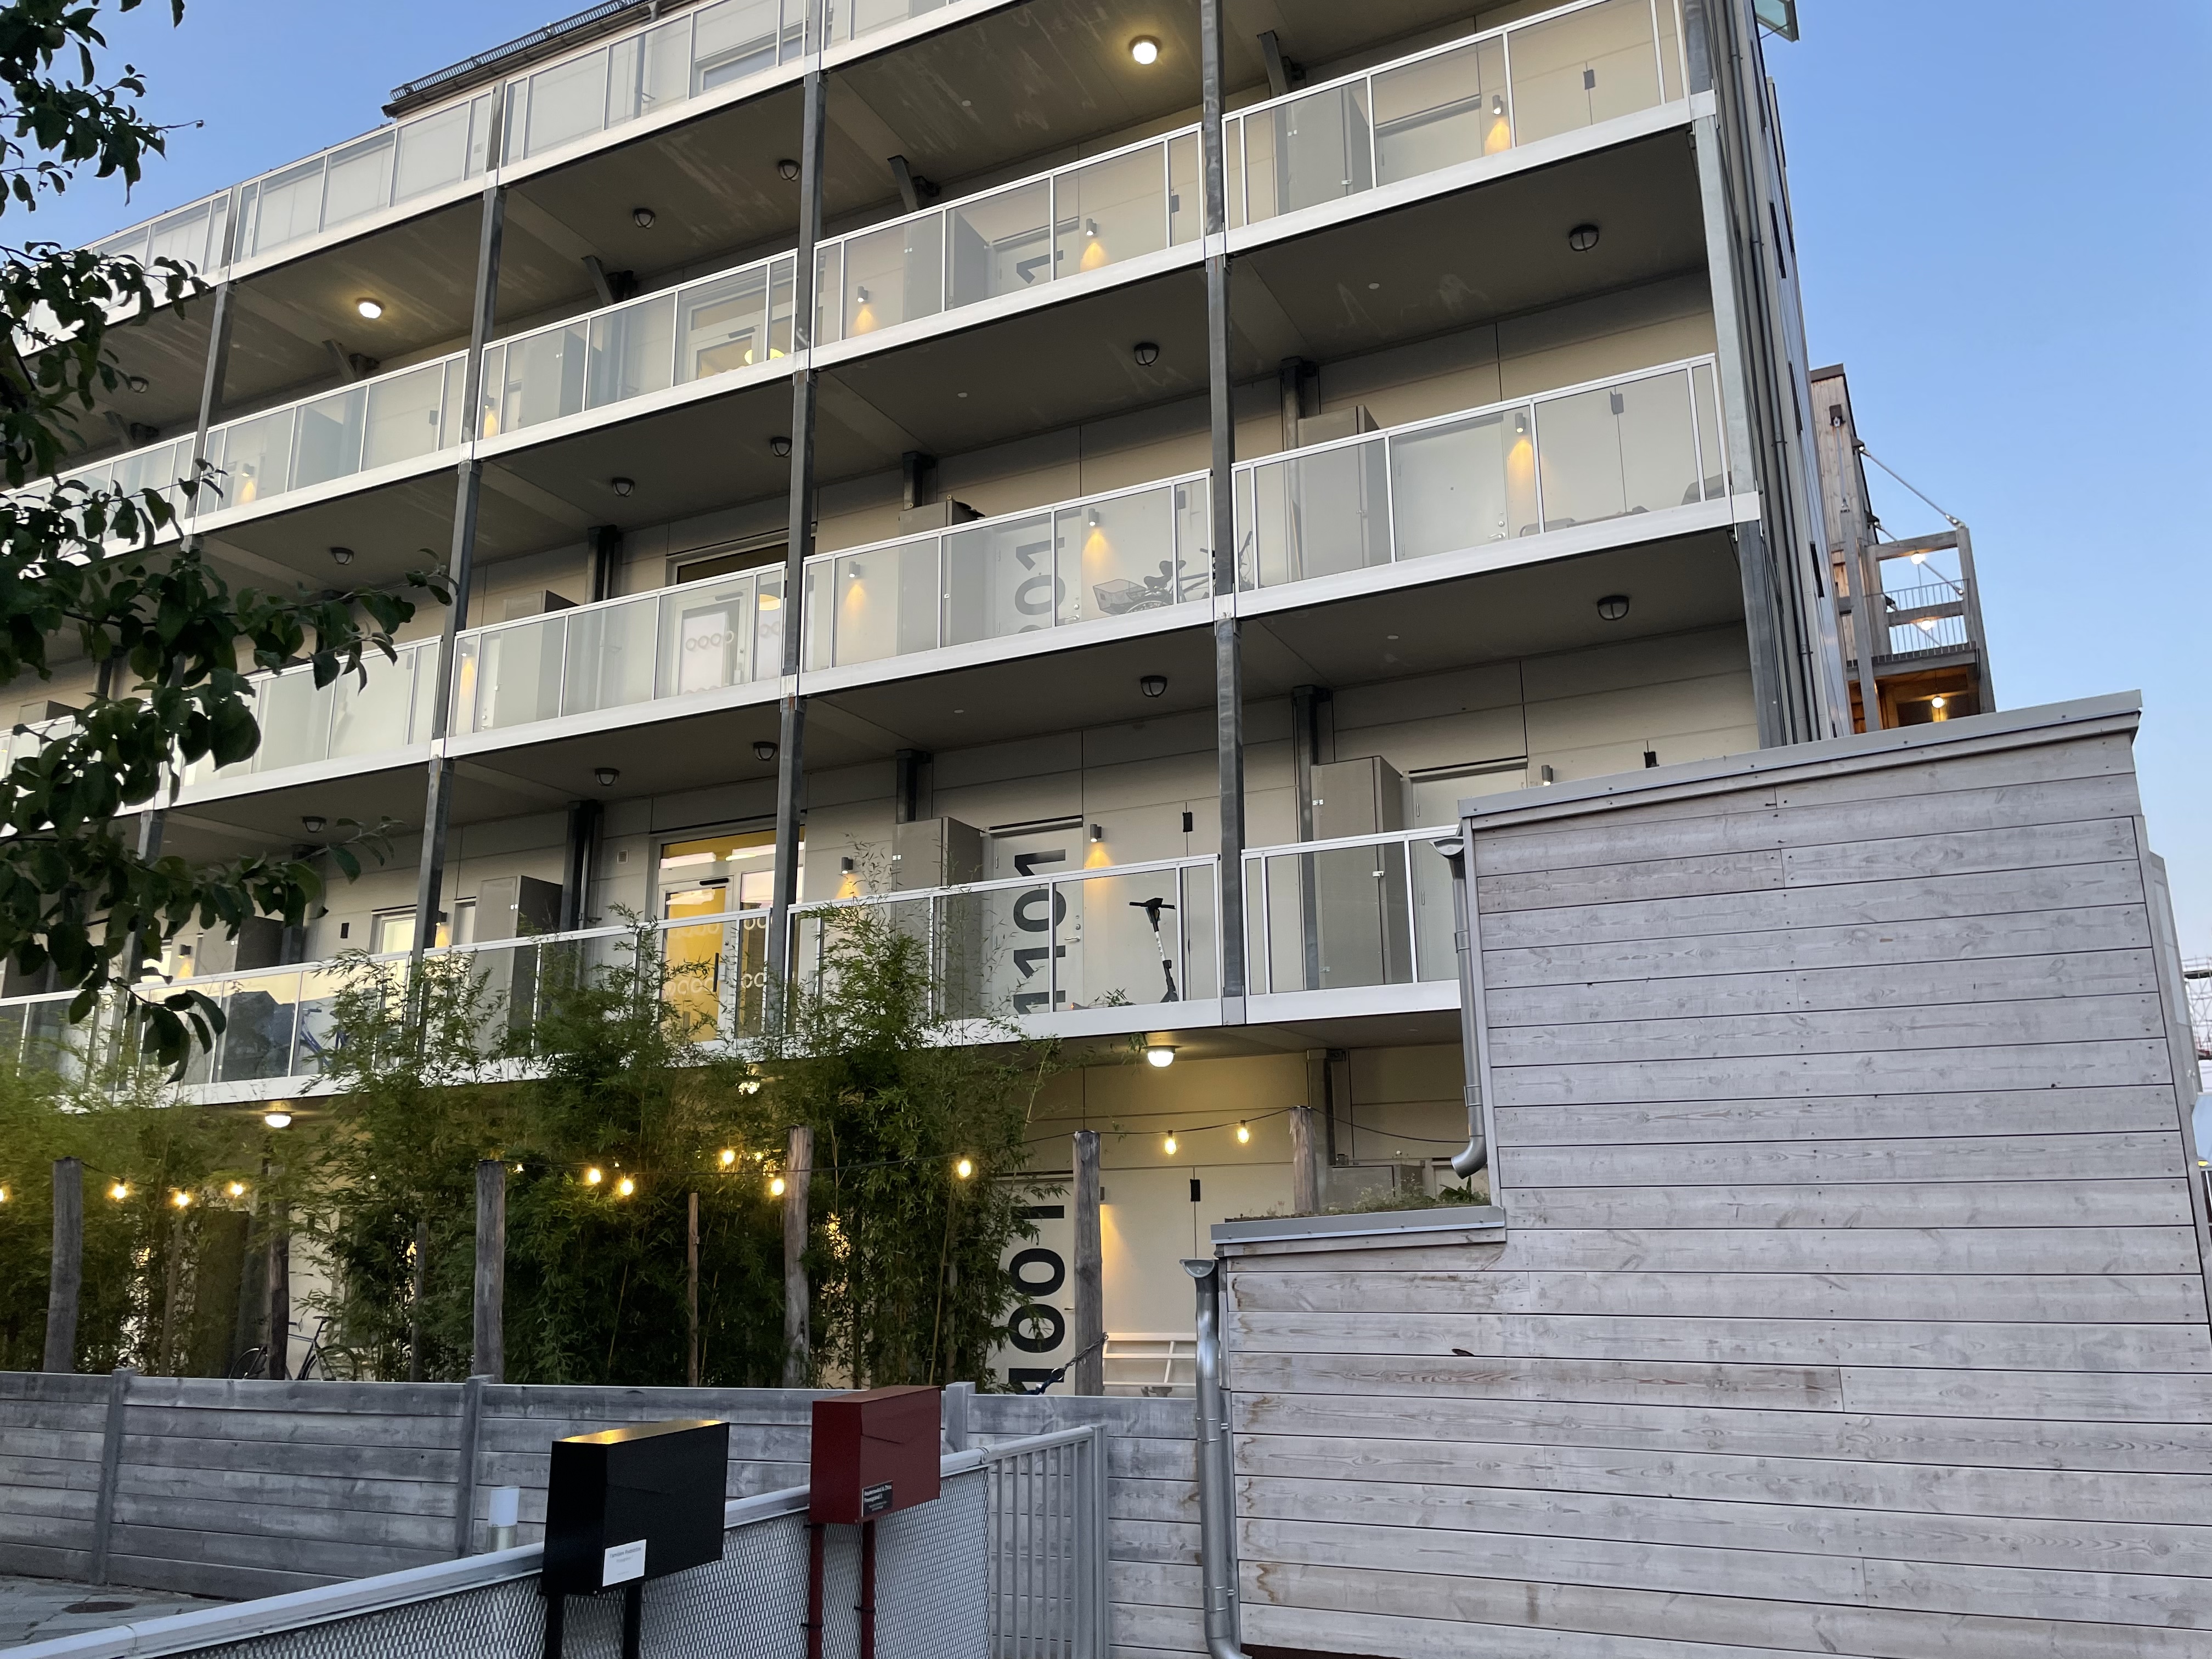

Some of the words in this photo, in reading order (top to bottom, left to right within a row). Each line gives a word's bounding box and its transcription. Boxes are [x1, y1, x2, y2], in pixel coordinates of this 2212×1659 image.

[1015, 537, 1065, 633] 01
[1013, 849, 1066, 1014] 1101
[1008, 1205, 1065, 1394] 1001
